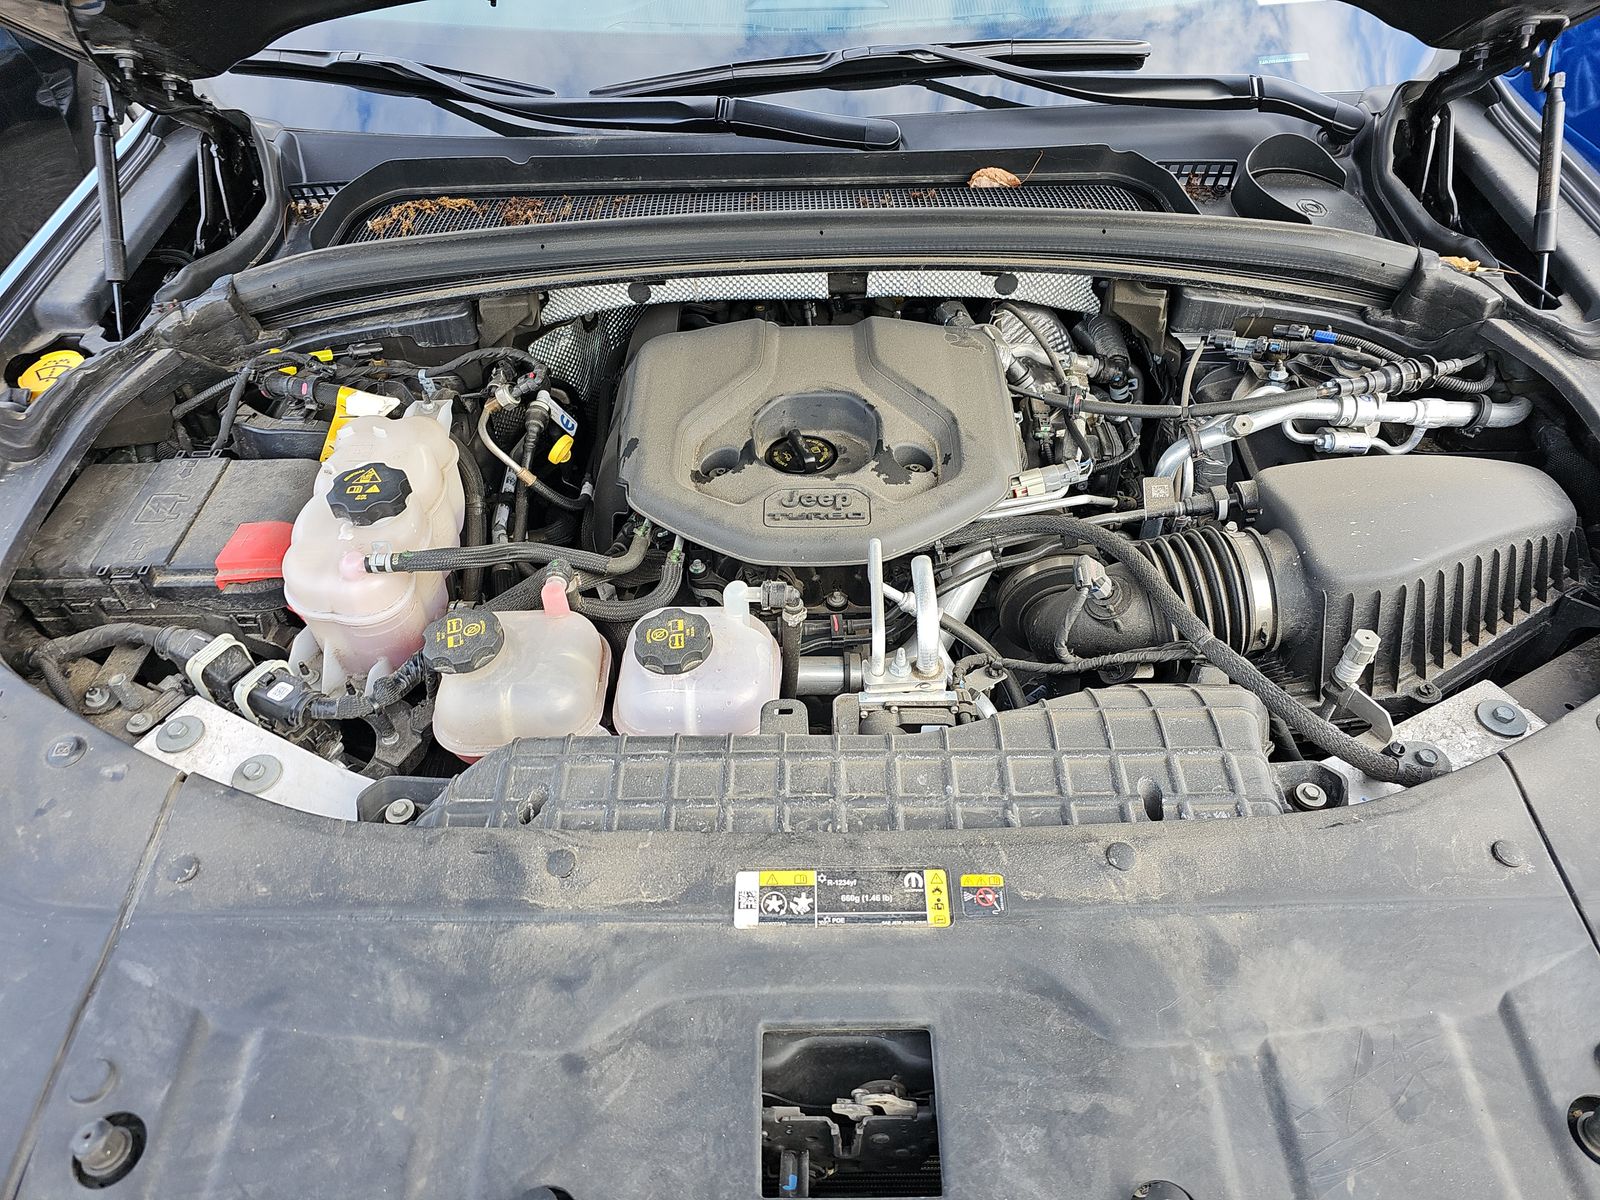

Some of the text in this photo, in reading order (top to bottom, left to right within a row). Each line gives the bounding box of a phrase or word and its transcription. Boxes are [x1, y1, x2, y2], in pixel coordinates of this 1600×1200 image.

[780, 489, 853, 511] Jeep
[767, 512, 866, 521] TURBO
[826, 879, 858, 888] R-1234yf
[882, 894, 894, 904] lb)
[831, 917, 846, 925] POE
